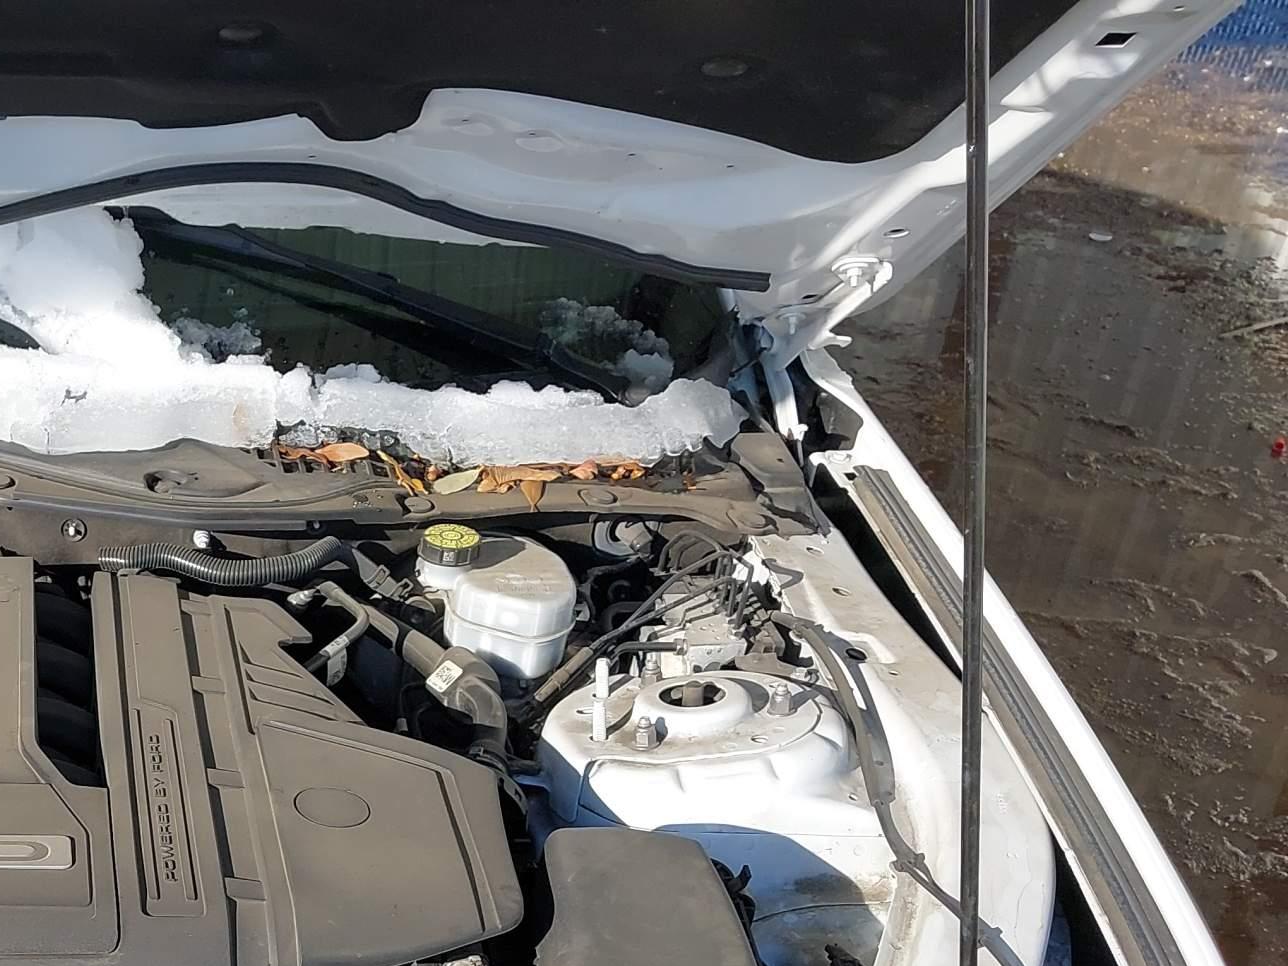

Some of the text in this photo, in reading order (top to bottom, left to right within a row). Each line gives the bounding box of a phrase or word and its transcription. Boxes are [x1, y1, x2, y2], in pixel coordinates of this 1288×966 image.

[148, 734, 179, 882] POWERED BY FORD
